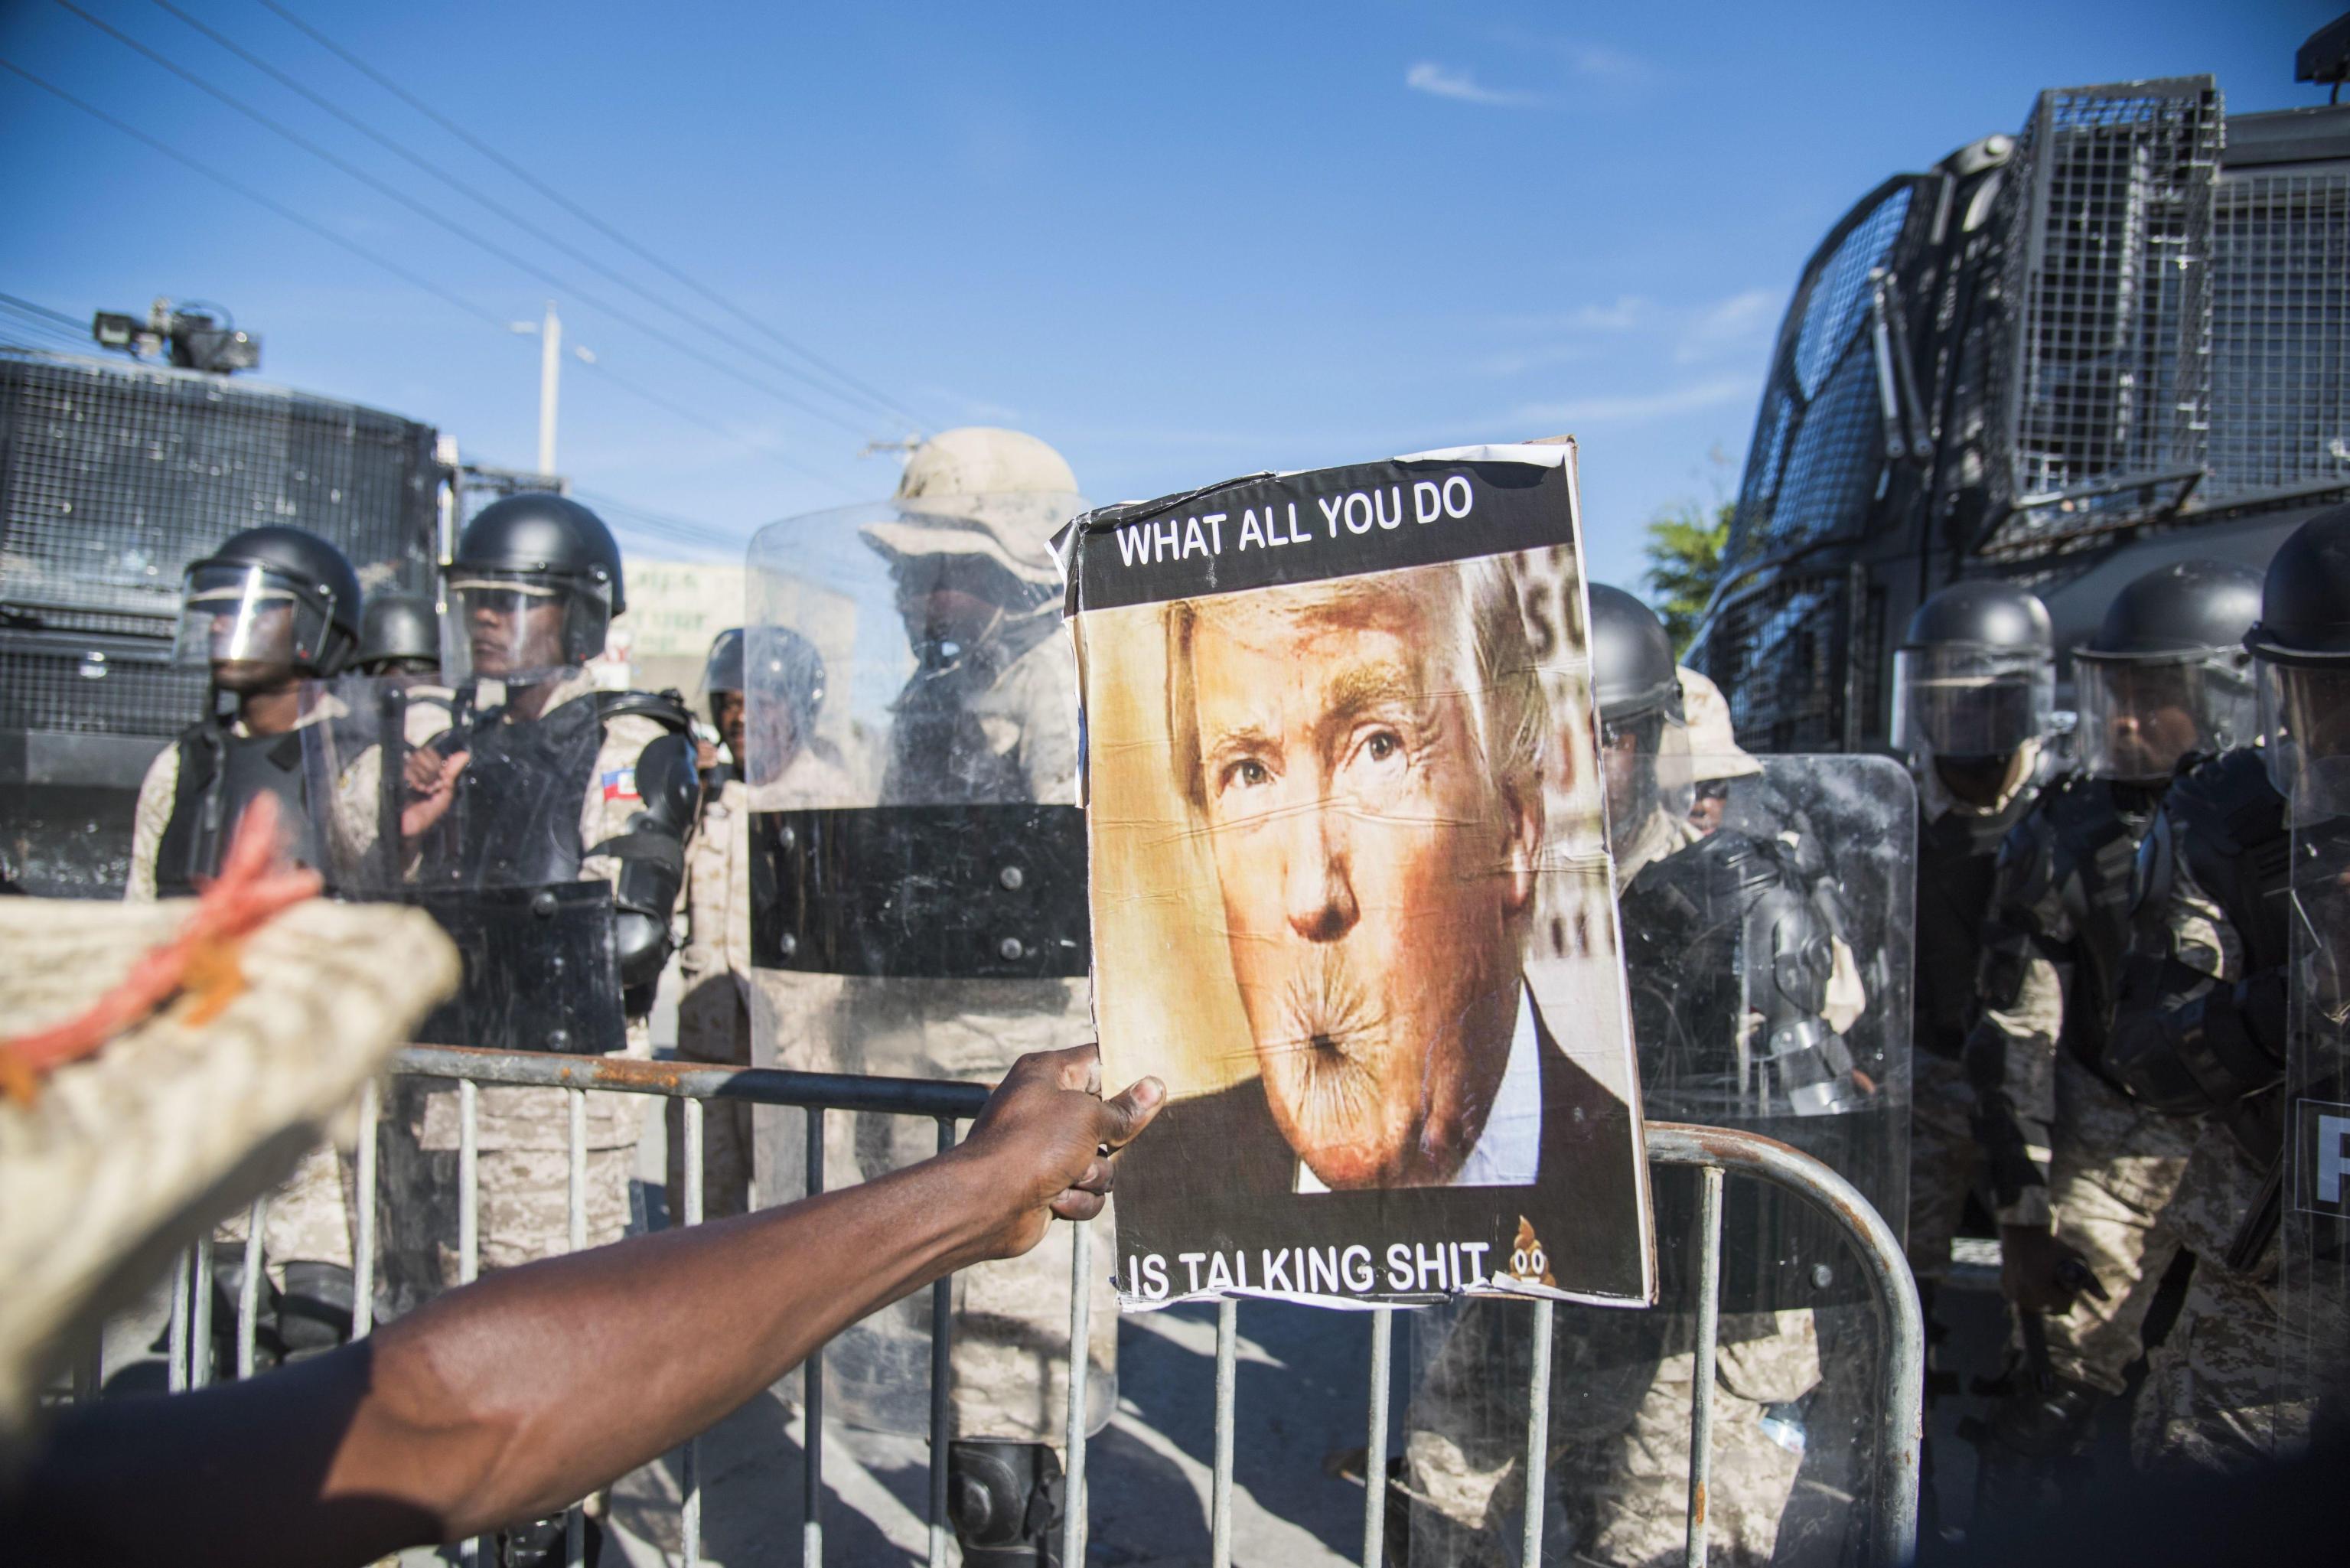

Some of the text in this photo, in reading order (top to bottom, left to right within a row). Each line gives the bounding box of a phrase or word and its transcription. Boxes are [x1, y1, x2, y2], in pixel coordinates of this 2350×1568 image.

[1116, 474, 1474, 568] WHAT ALL YOU DO
[1129, 1240, 1491, 1300] IS TALKING SHIT
